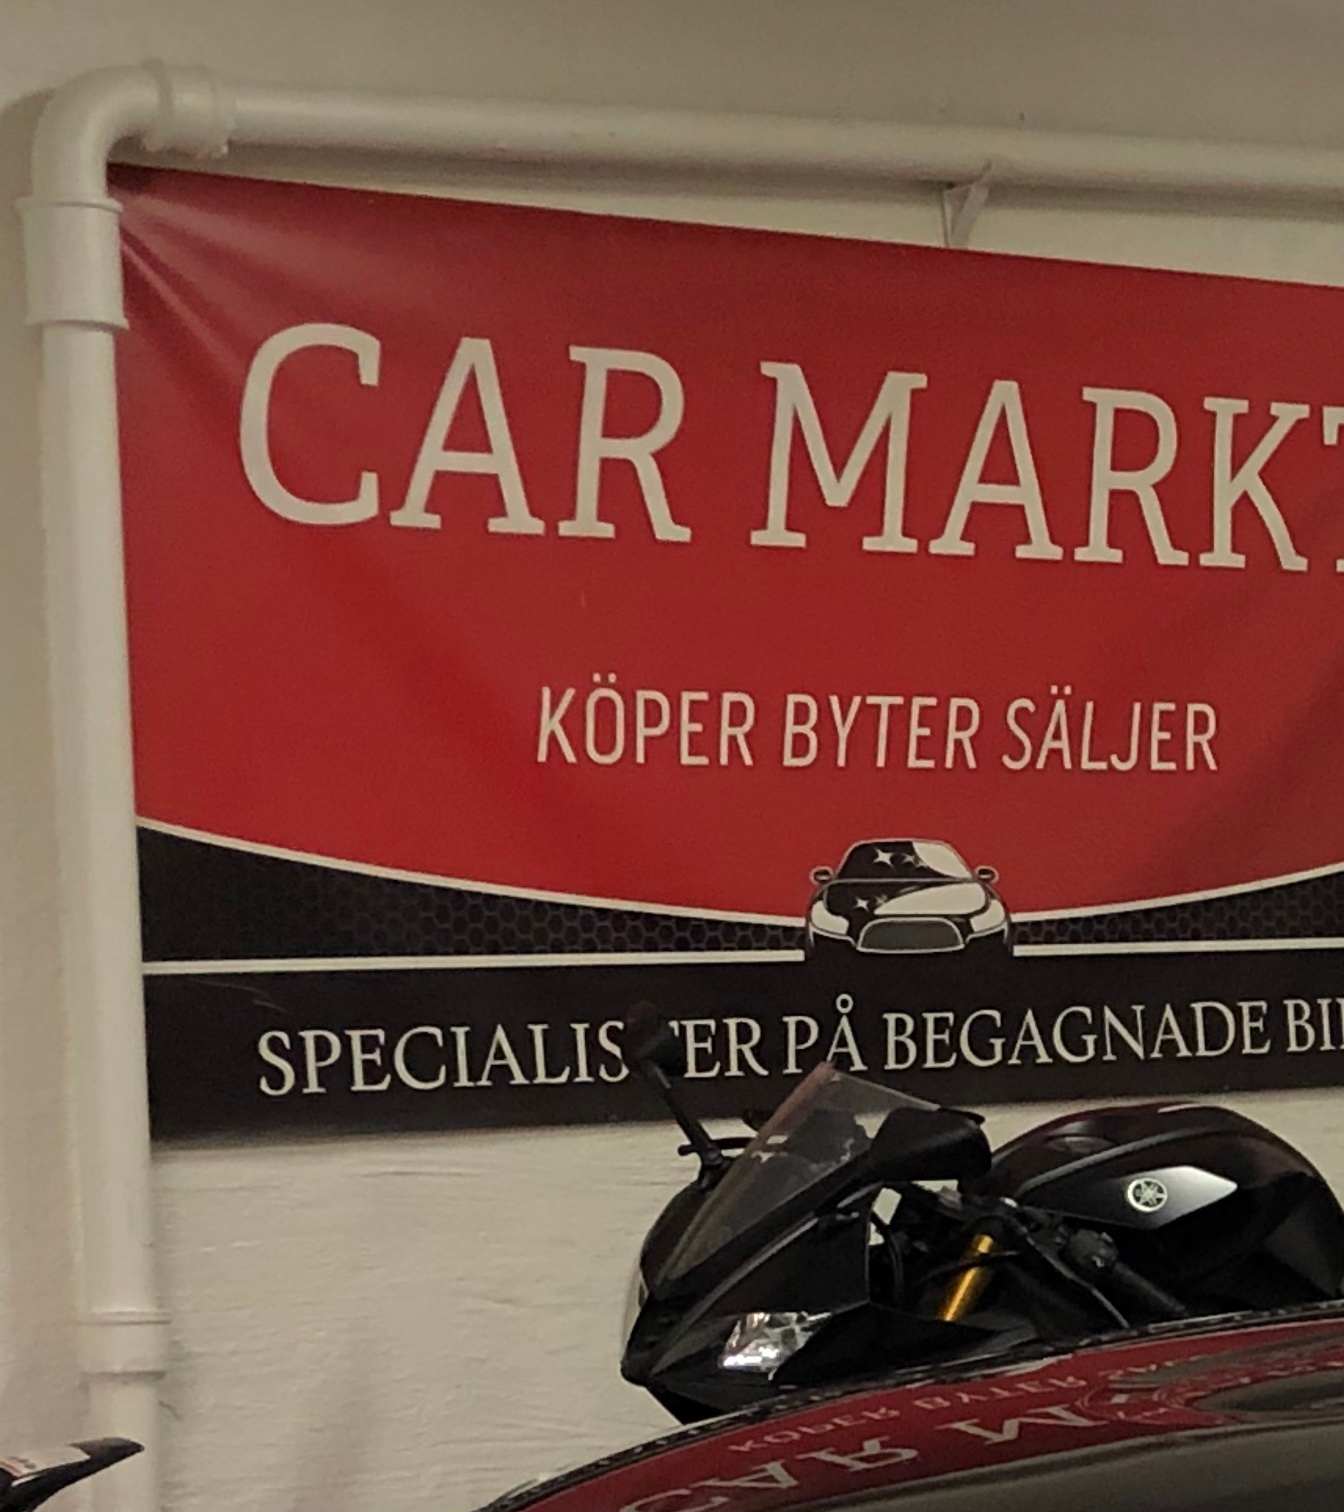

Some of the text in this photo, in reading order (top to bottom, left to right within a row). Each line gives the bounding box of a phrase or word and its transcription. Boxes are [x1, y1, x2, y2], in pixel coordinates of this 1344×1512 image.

[237, 321, 693, 545] CAR
[535, 670, 1220, 773] KÖPER BYTER SÄLJER
[257, 1017, 770, 1098] SPECIALISER
[781, 992, 870, 1075] PÅ
[881, 999, 1273, 1071] BEGAGNADE
